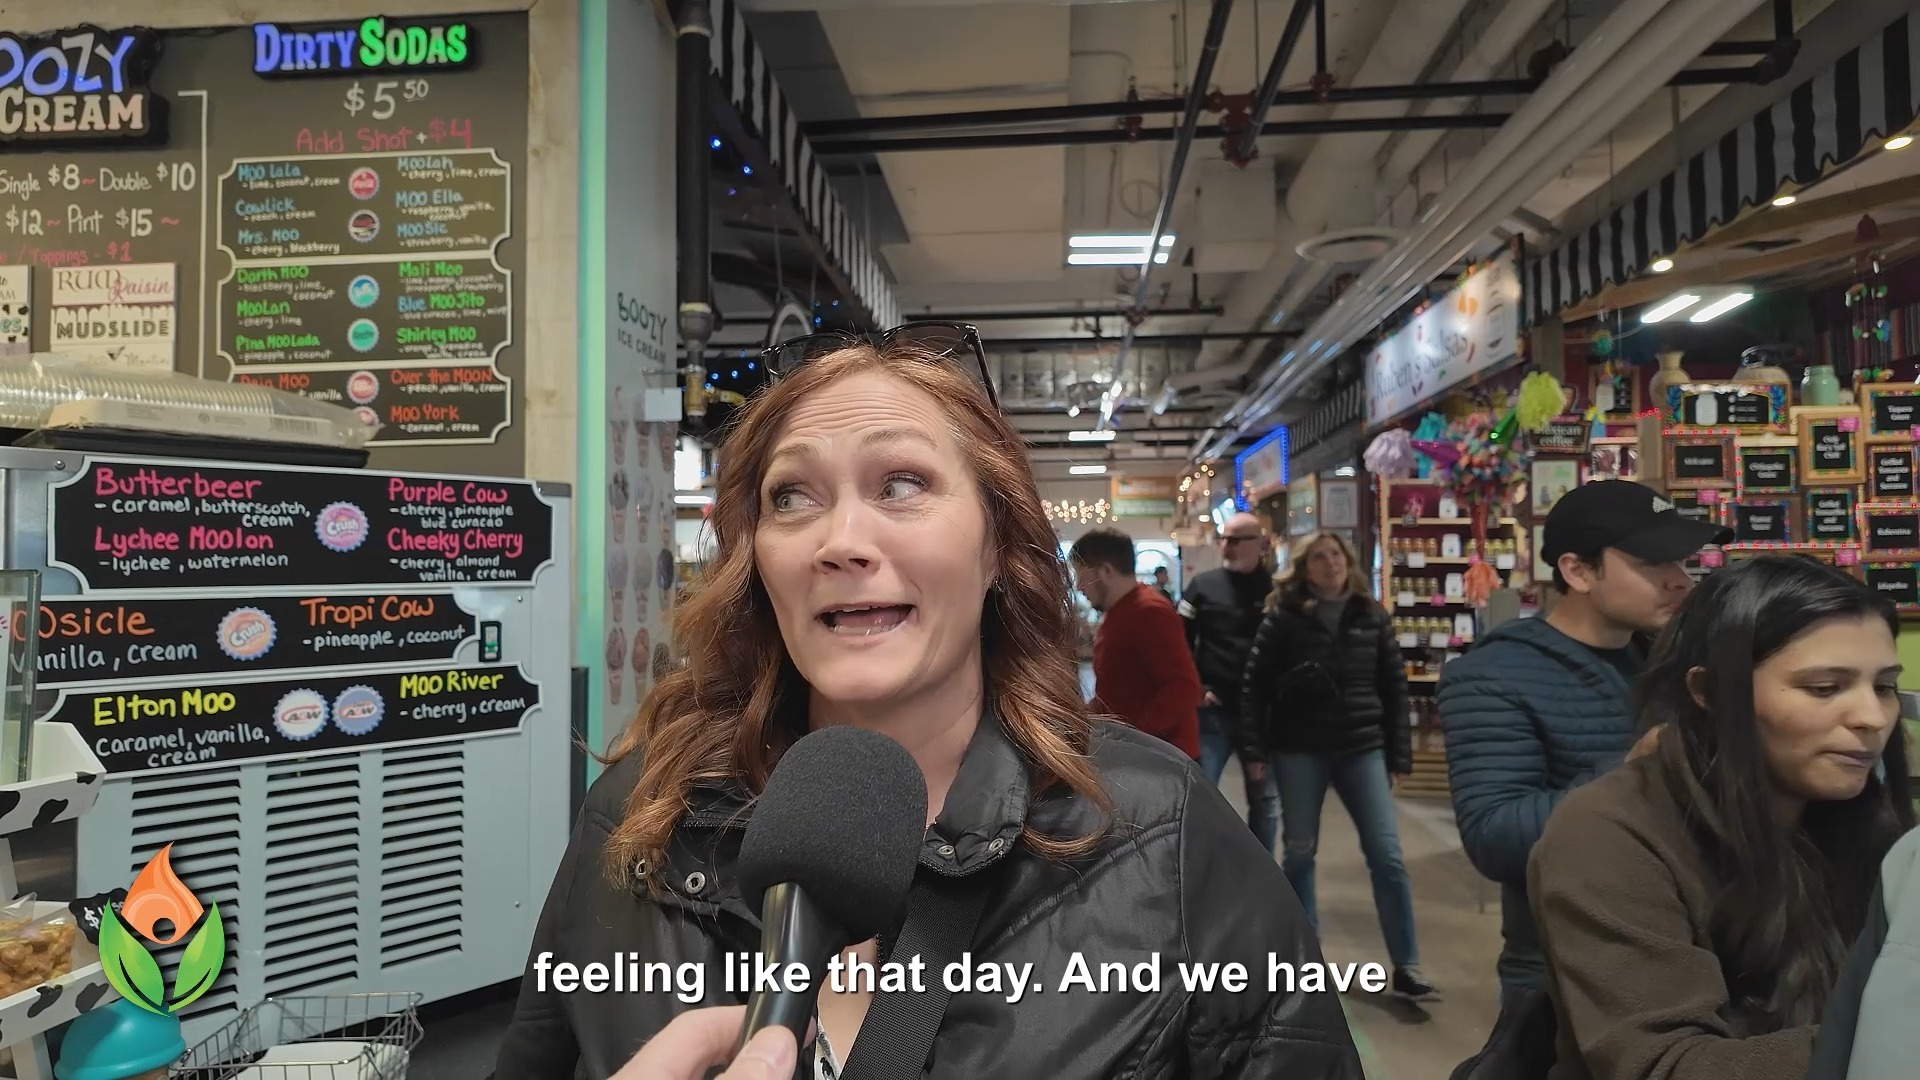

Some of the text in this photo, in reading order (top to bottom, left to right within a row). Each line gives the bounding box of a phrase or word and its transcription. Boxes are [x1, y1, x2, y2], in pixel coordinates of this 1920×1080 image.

[296, 128, 344, 153] Add
[357, 126, 413, 151] Shot
[100, 169, 151, 191] Double
[156, 162, 196, 191] $10
[6, 204, 153, 237] $12 Pint $15
[397, 295, 427, 313] Blue
[56, 319, 170, 340] MUDSLIDE
[617, 292, 668, 347] BOOZY
[617, 328, 667, 366] ICE CREAM
[390, 369, 423, 384] Over
[427, 368, 450, 383] the
[95, 466, 263, 499] Butterbeer
[388, 477, 508, 506] Purple Cow
[242, 513, 294, 528] cream
[454, 504, 515, 519] pineapple
[421, 517, 504, 530] blue curacao
[94, 526, 180, 557] Lychee
[387, 527, 523, 559] Cheeky Cherry
[455, 555, 501, 568] almond
[476, 568, 518, 581] cream
[300, 596, 435, 629] Tropi Cow
[406, 624, 466, 645] coconut
[127, 641, 199, 665] cream
[447, 671, 504, 693] River
[93, 694, 177, 727] Elton
[479, 697, 526, 714] cream
[147, 746, 217, 768] cream
